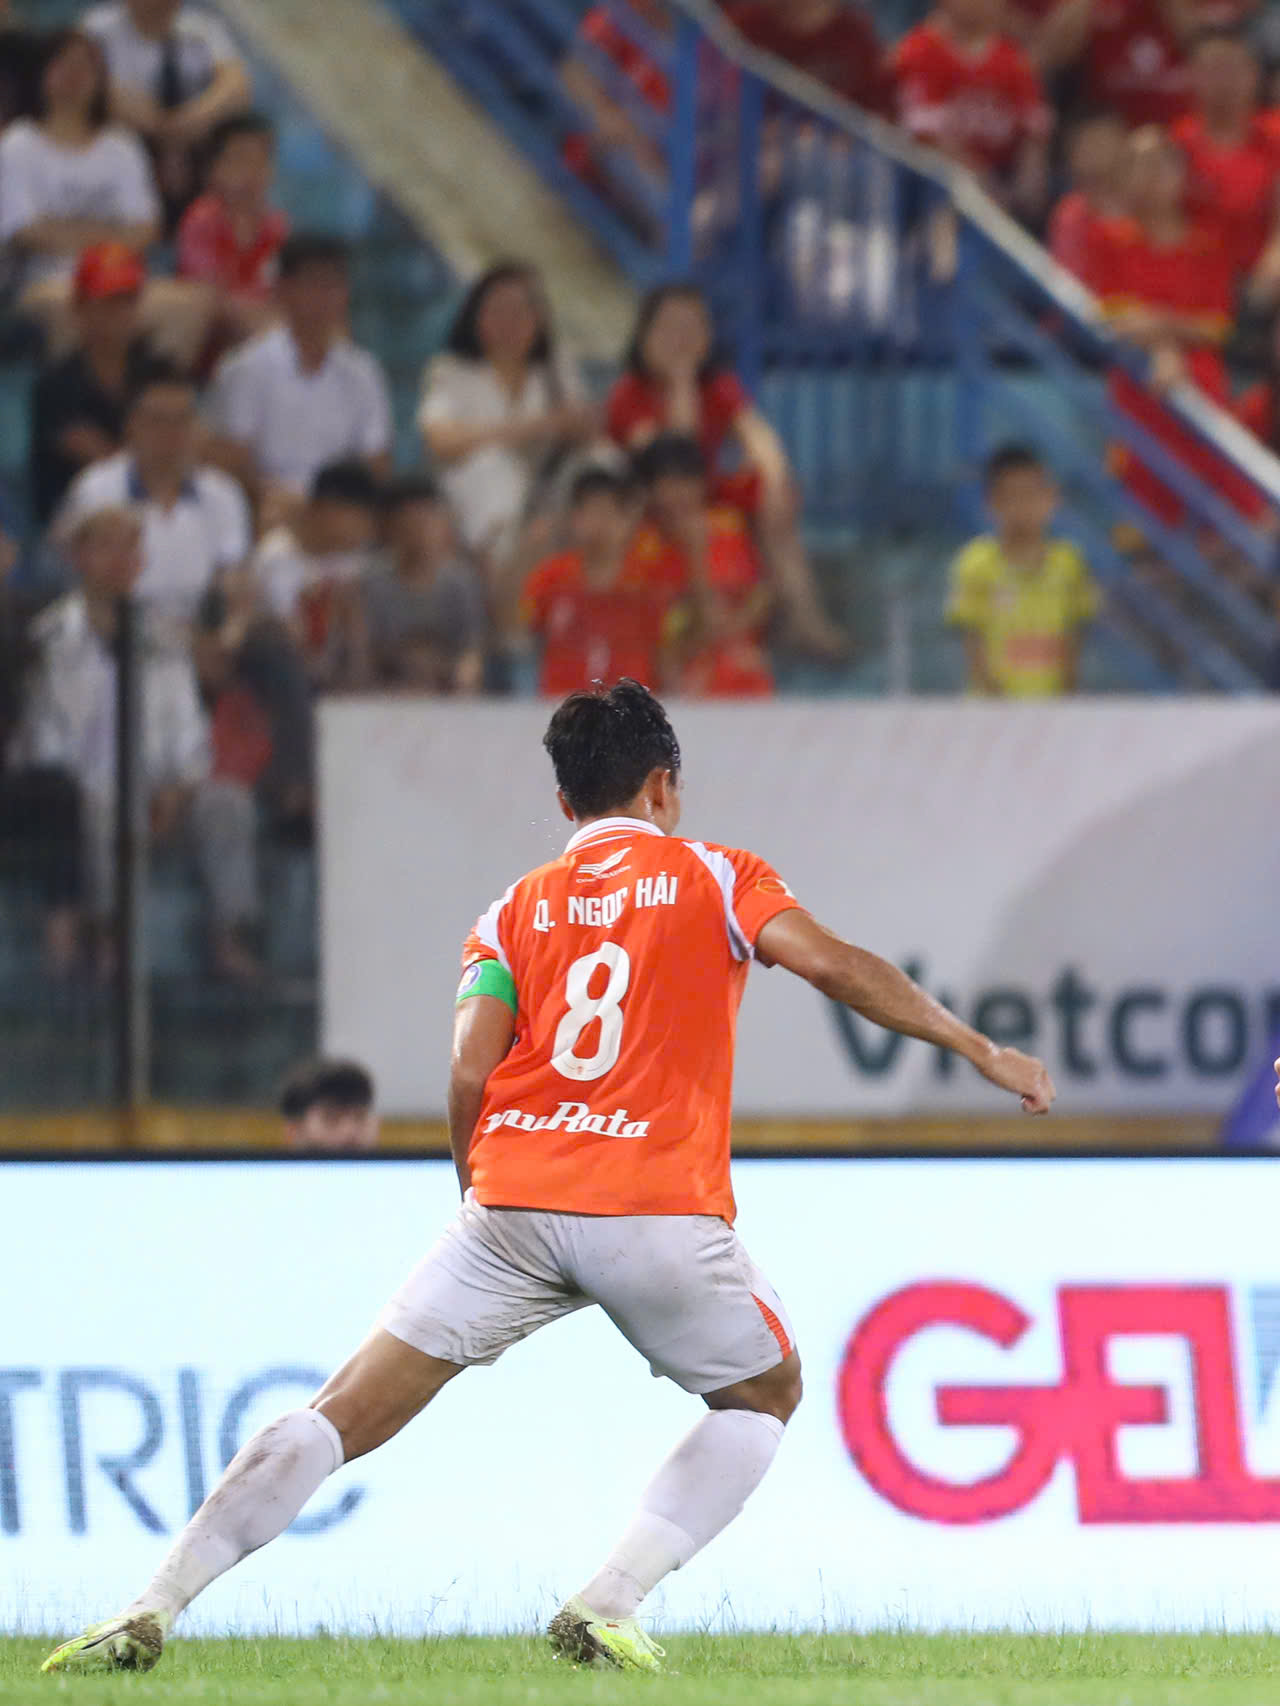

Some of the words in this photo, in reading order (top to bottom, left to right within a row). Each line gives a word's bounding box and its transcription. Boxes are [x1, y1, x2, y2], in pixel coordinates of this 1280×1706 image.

[533, 899, 556, 933] Q.
[635, 871, 678, 909] HẢI
[551, 941, 630, 1081] 8
